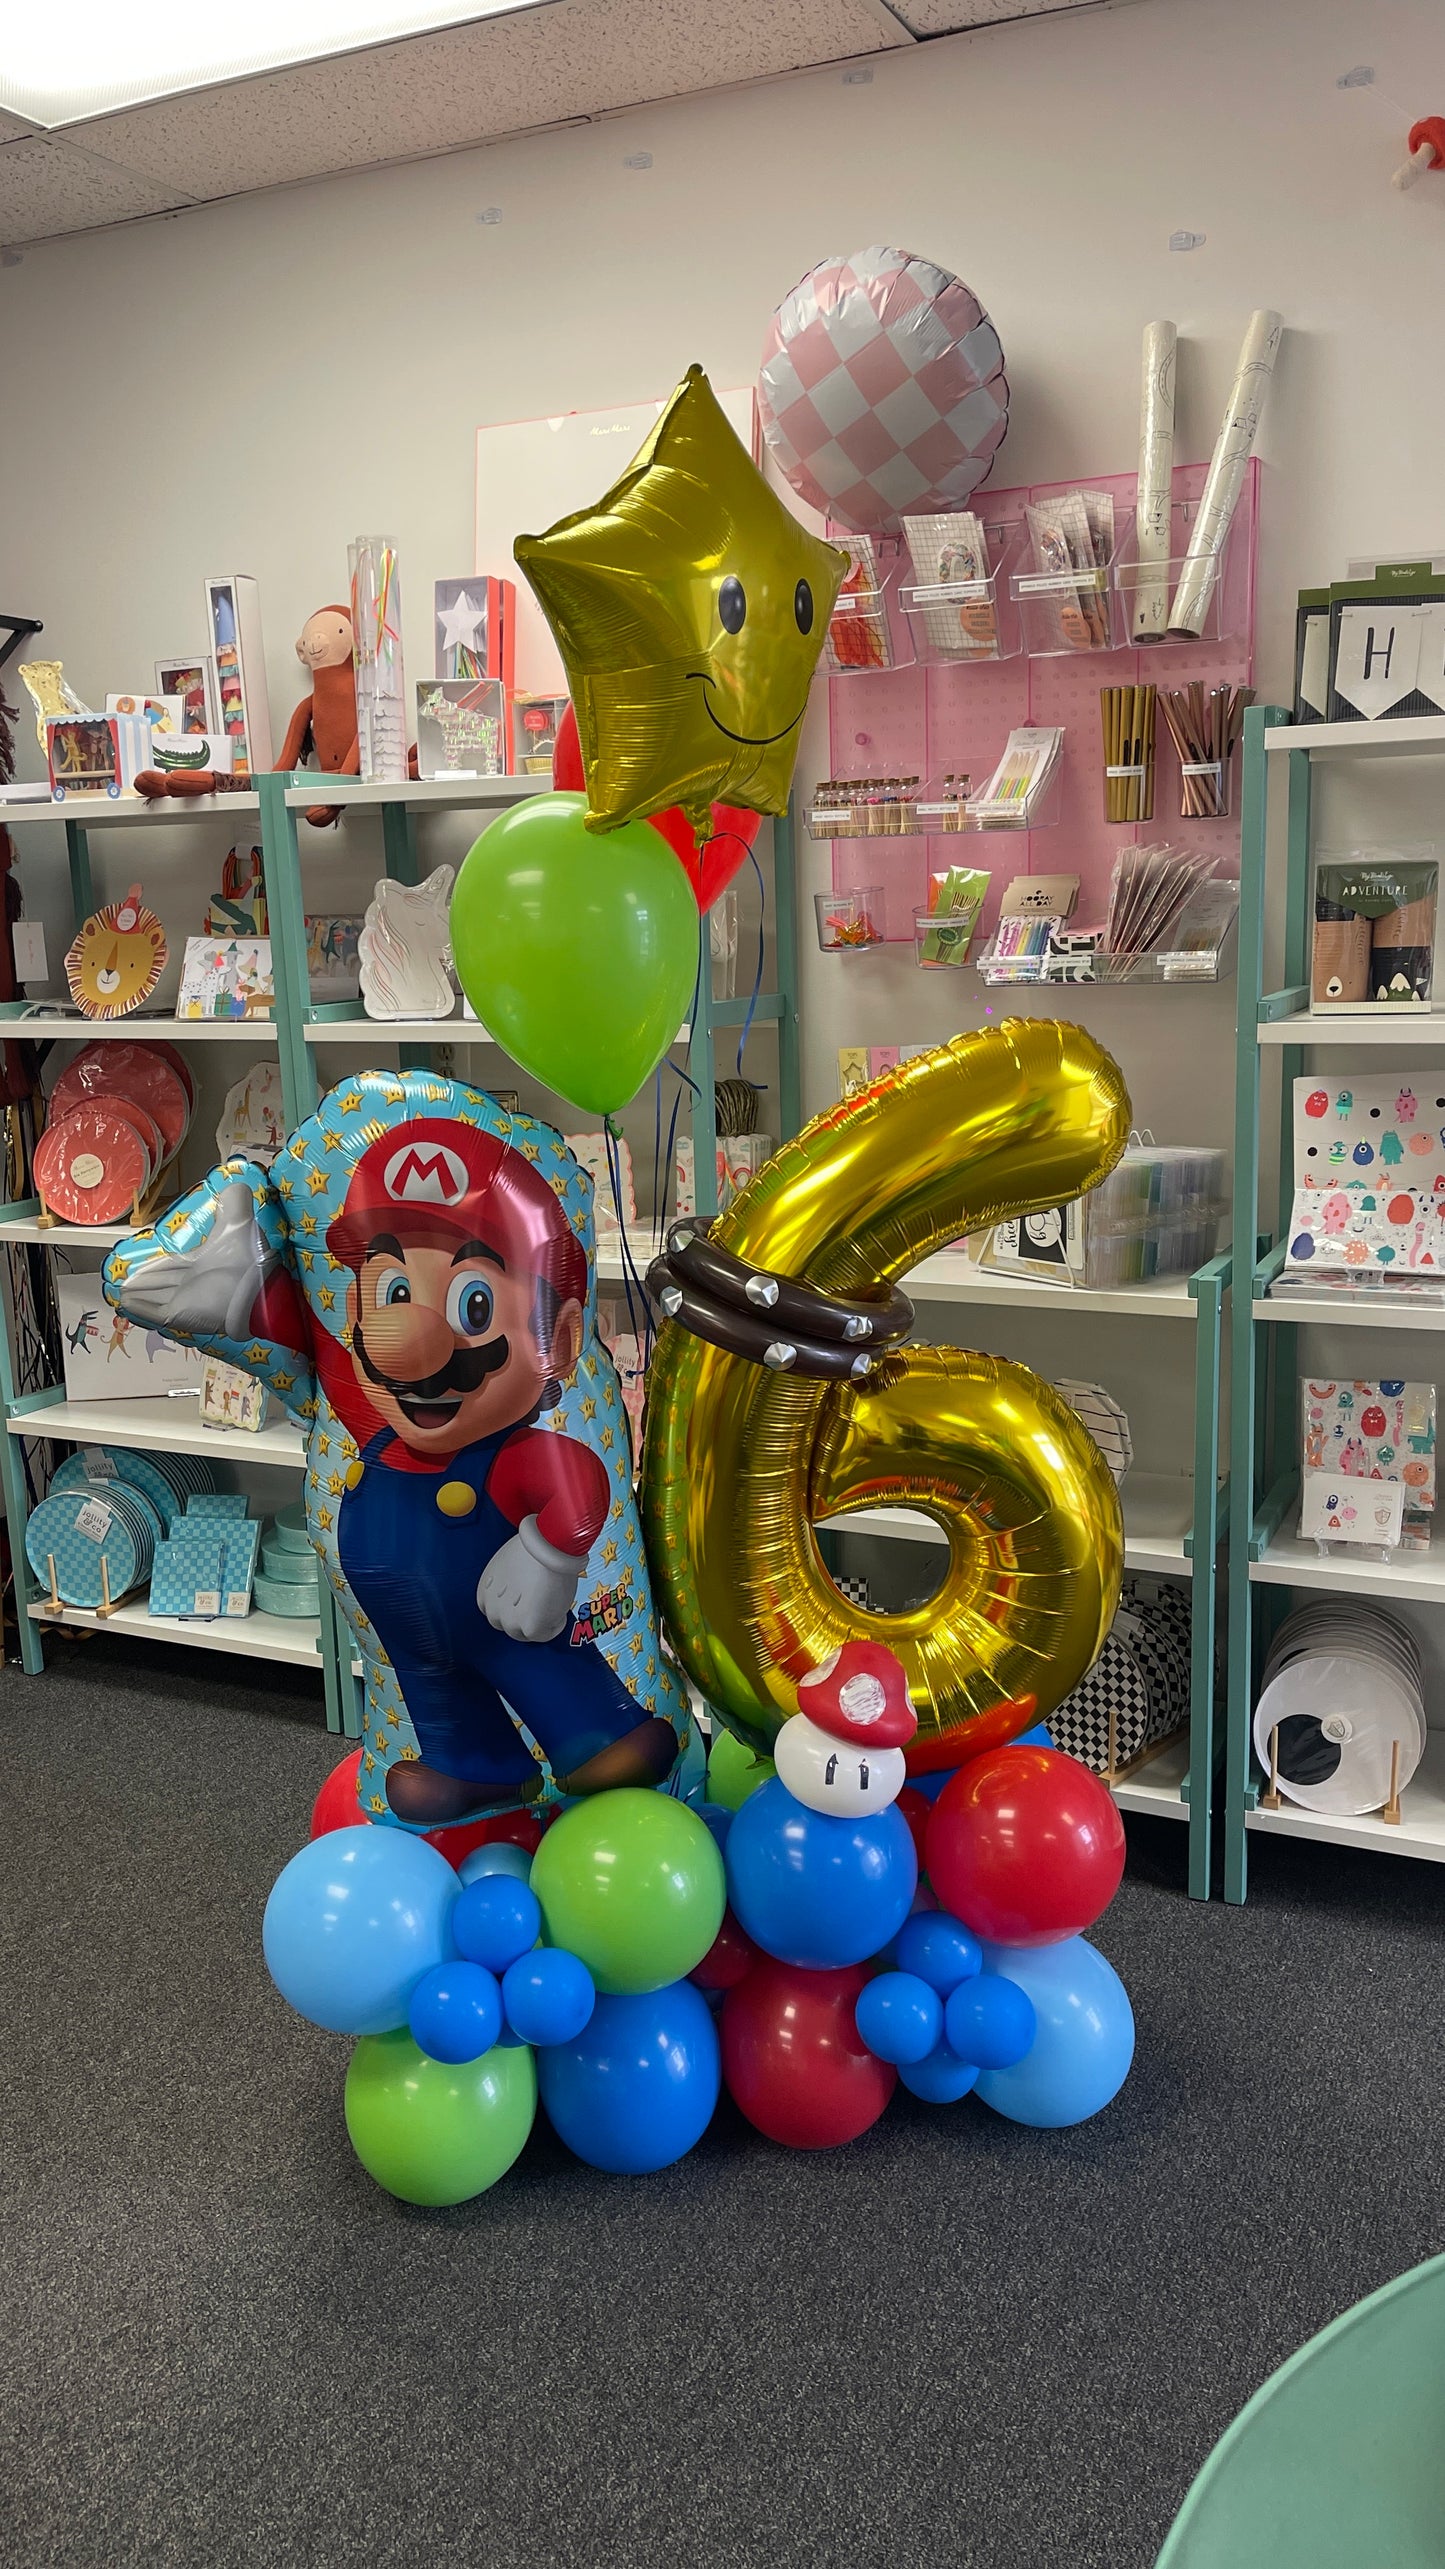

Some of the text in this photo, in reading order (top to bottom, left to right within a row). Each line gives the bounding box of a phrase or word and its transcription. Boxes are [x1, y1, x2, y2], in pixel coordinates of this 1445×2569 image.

[1363, 626, 1395, 680] H
[1342, 885, 1408, 896] ADVENTURE
[391, 1148, 459, 1200] M
[615, 1353, 635, 1368] jollity
[87, 1462, 113, 1475] jollity
[82, 1510, 107, 1529] jollity
[91, 1524, 102, 1533] co
[578, 1583, 627, 1621] SUPER
[571, 1596, 634, 1646] MARIO
